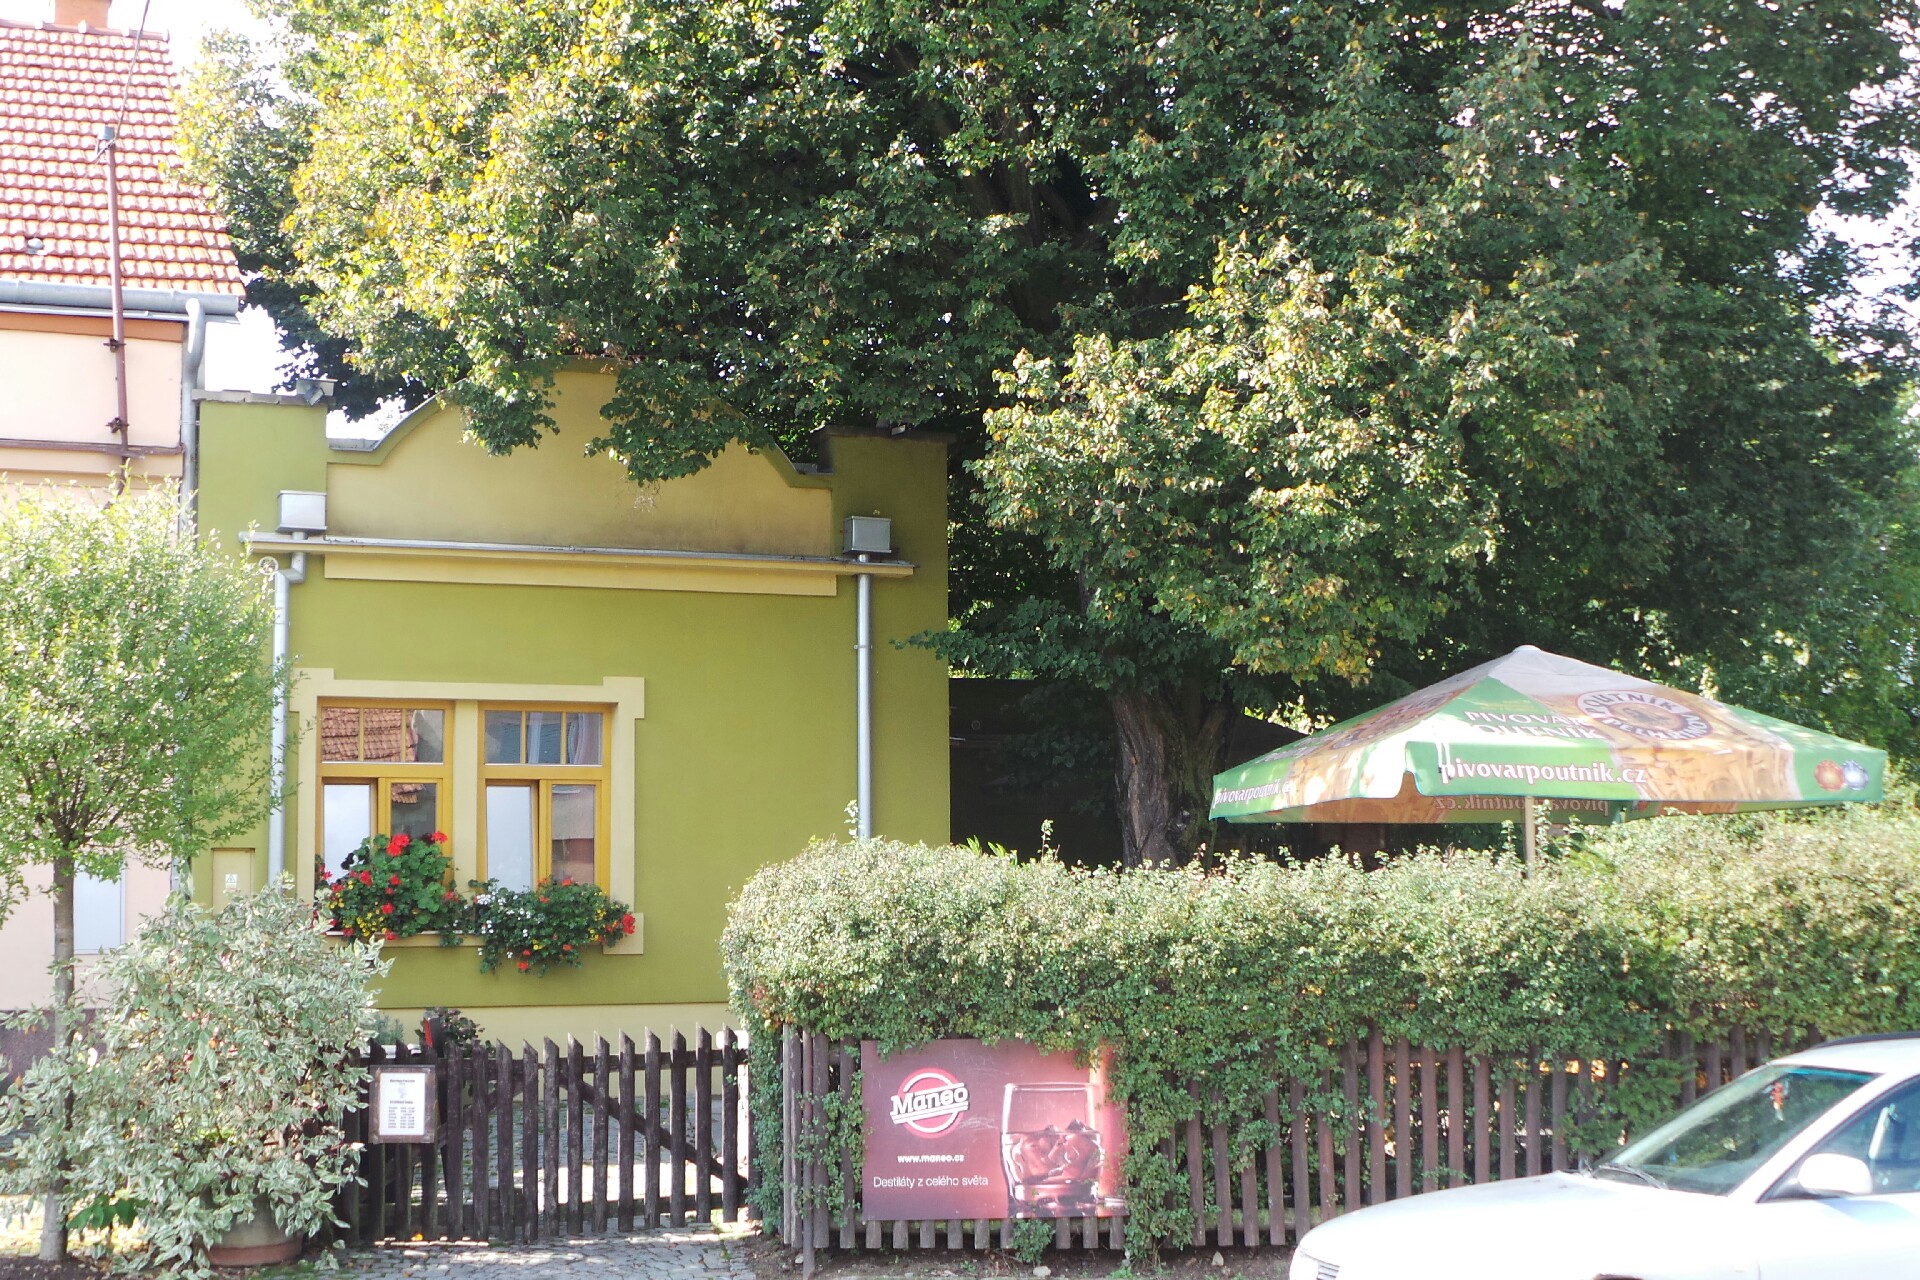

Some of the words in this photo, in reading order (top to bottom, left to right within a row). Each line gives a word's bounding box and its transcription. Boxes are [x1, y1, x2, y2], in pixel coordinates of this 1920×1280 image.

[1464, 711, 1597, 727] PIVOVAR
[1441, 758, 1647, 784] pivovarpoutnik.cz
[890, 1087, 968, 1115] Maneo
[897, 1154, 965, 1163] www.maneo.cz
[873, 1176, 915, 1189] Destiláty
[917, 1178, 924, 1187] z
[925, 1175, 959, 1186] celého
[961, 1174, 989, 1186] světa
